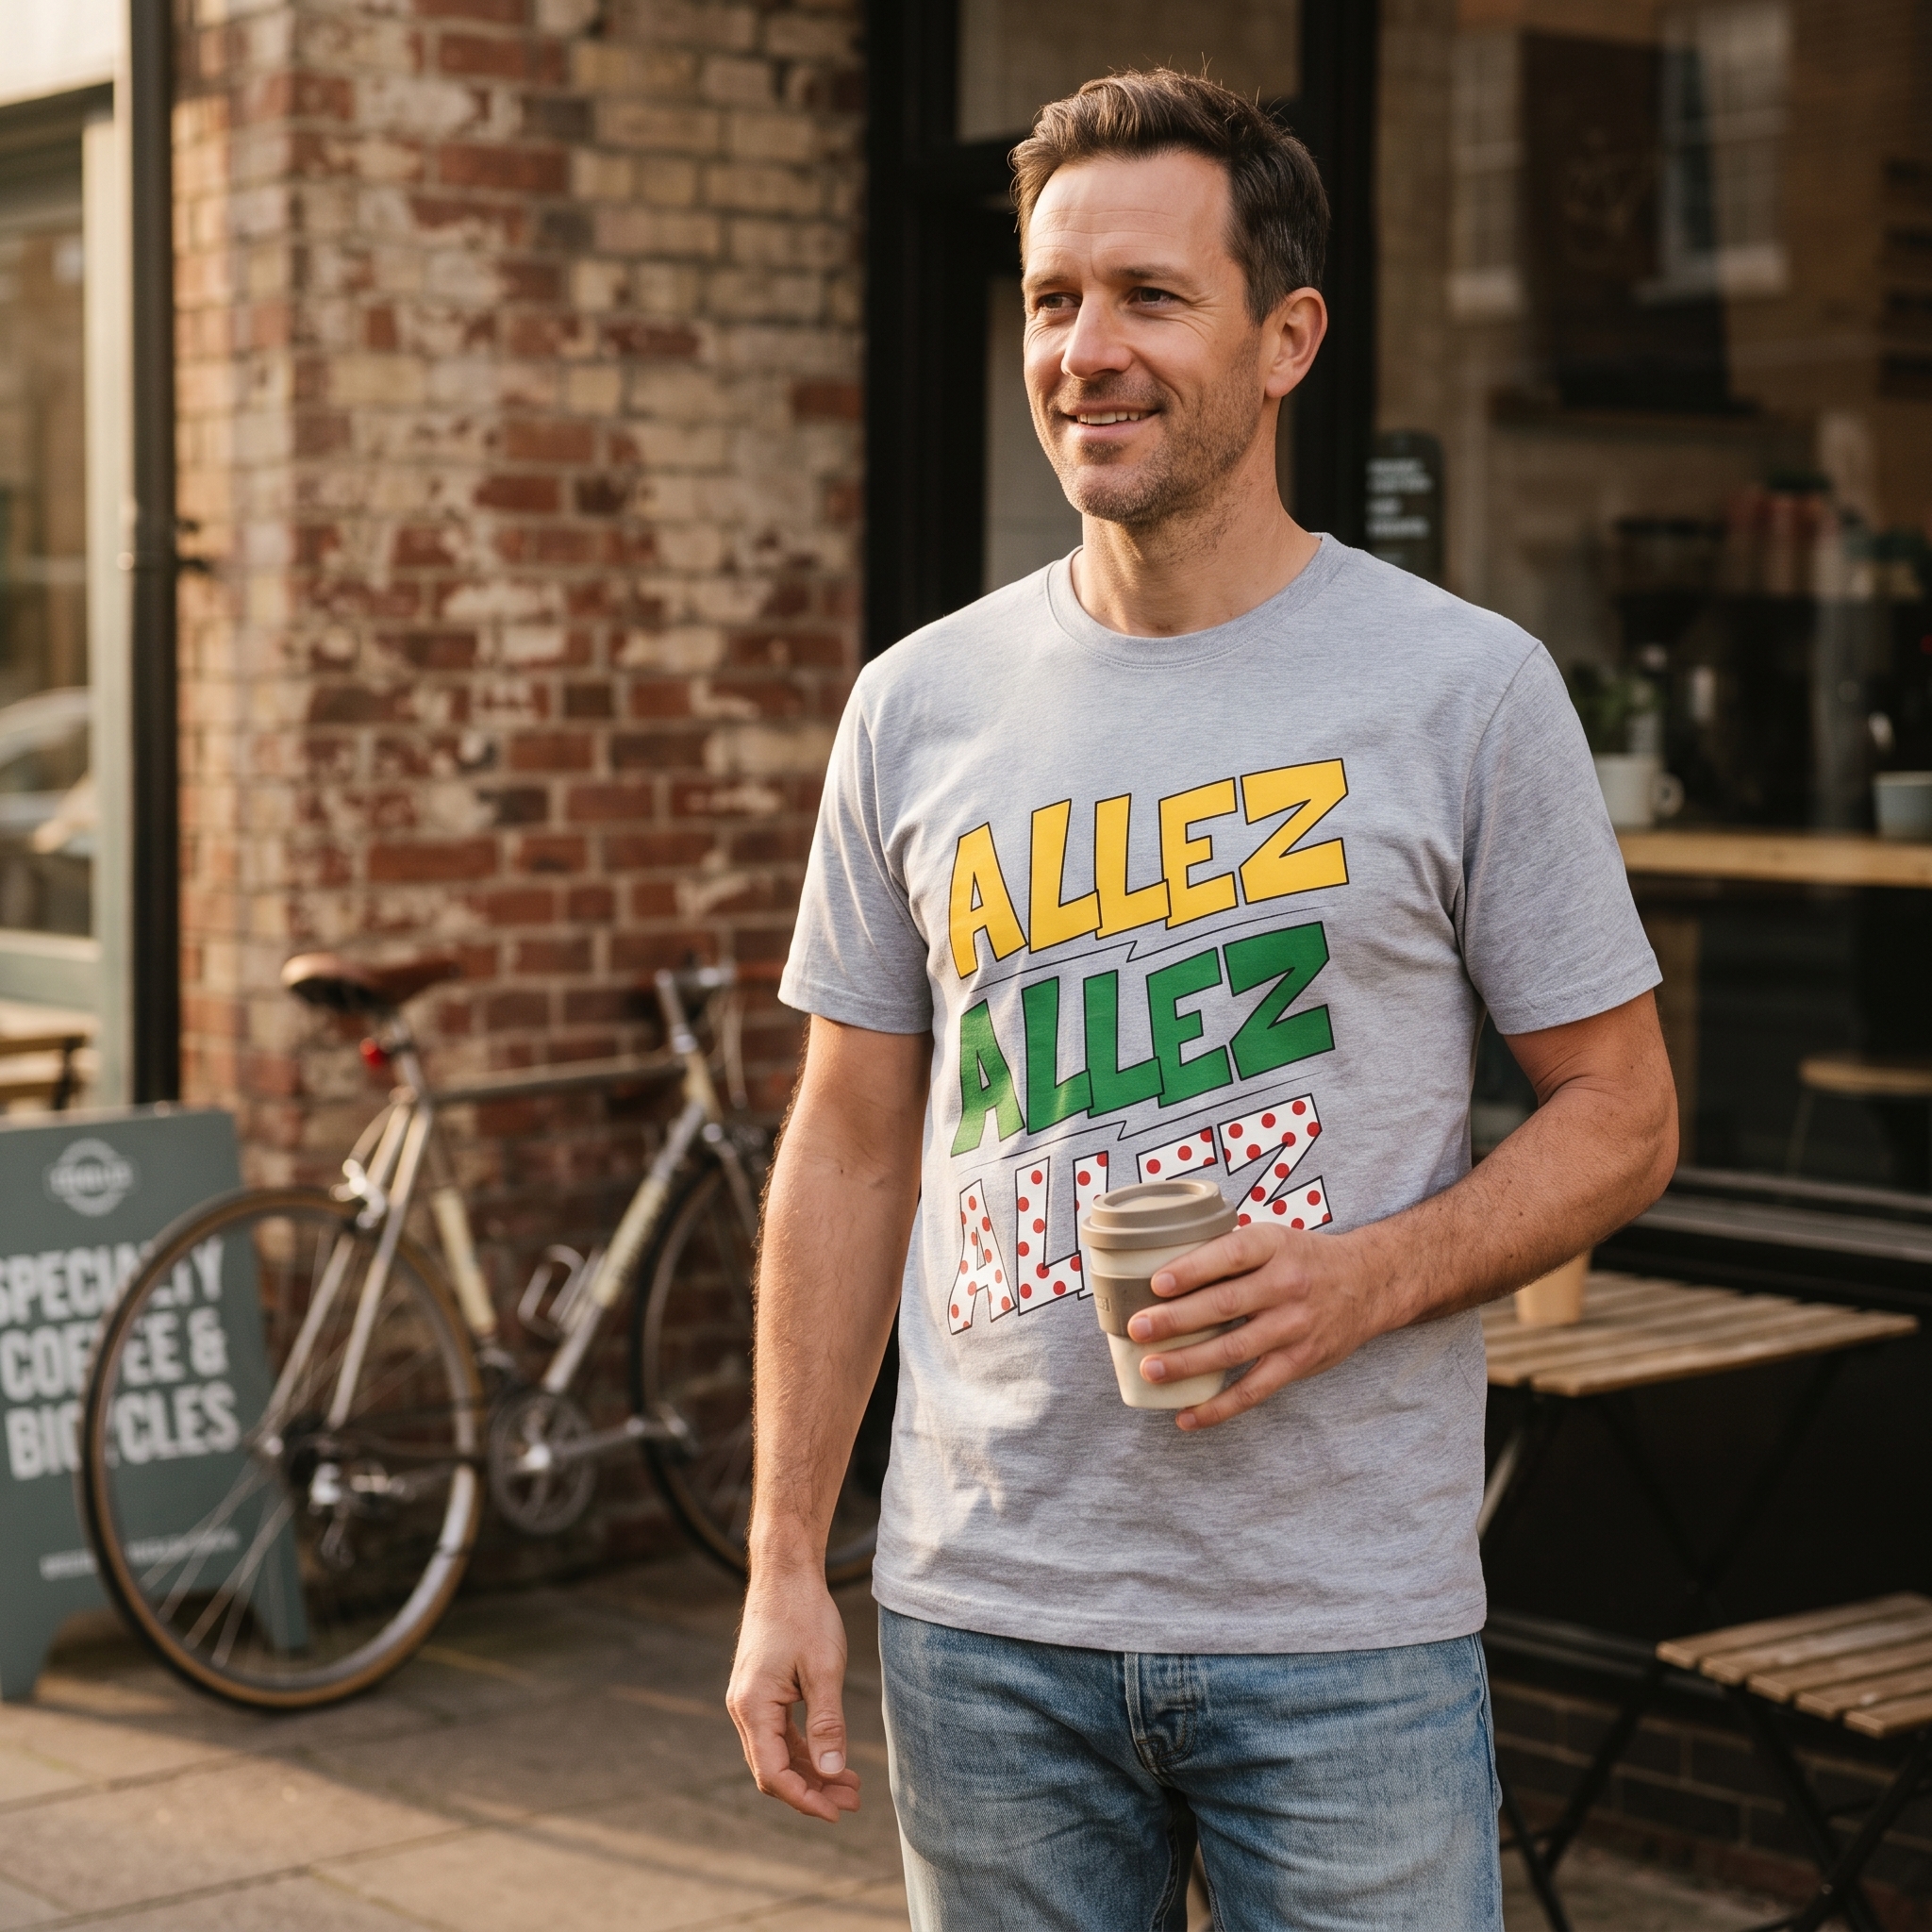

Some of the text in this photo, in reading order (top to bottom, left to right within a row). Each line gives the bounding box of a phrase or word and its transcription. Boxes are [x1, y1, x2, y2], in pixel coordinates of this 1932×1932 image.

[948, 758, 1350, 980] ALLEZ
[950, 921, 1336, 1158] ALLEZ
[946, 1092, 1333, 1336] ALZ
[1, 1306, 230, 1403] COFEE &
[5, 1380, 242, 1481] BICCLES
